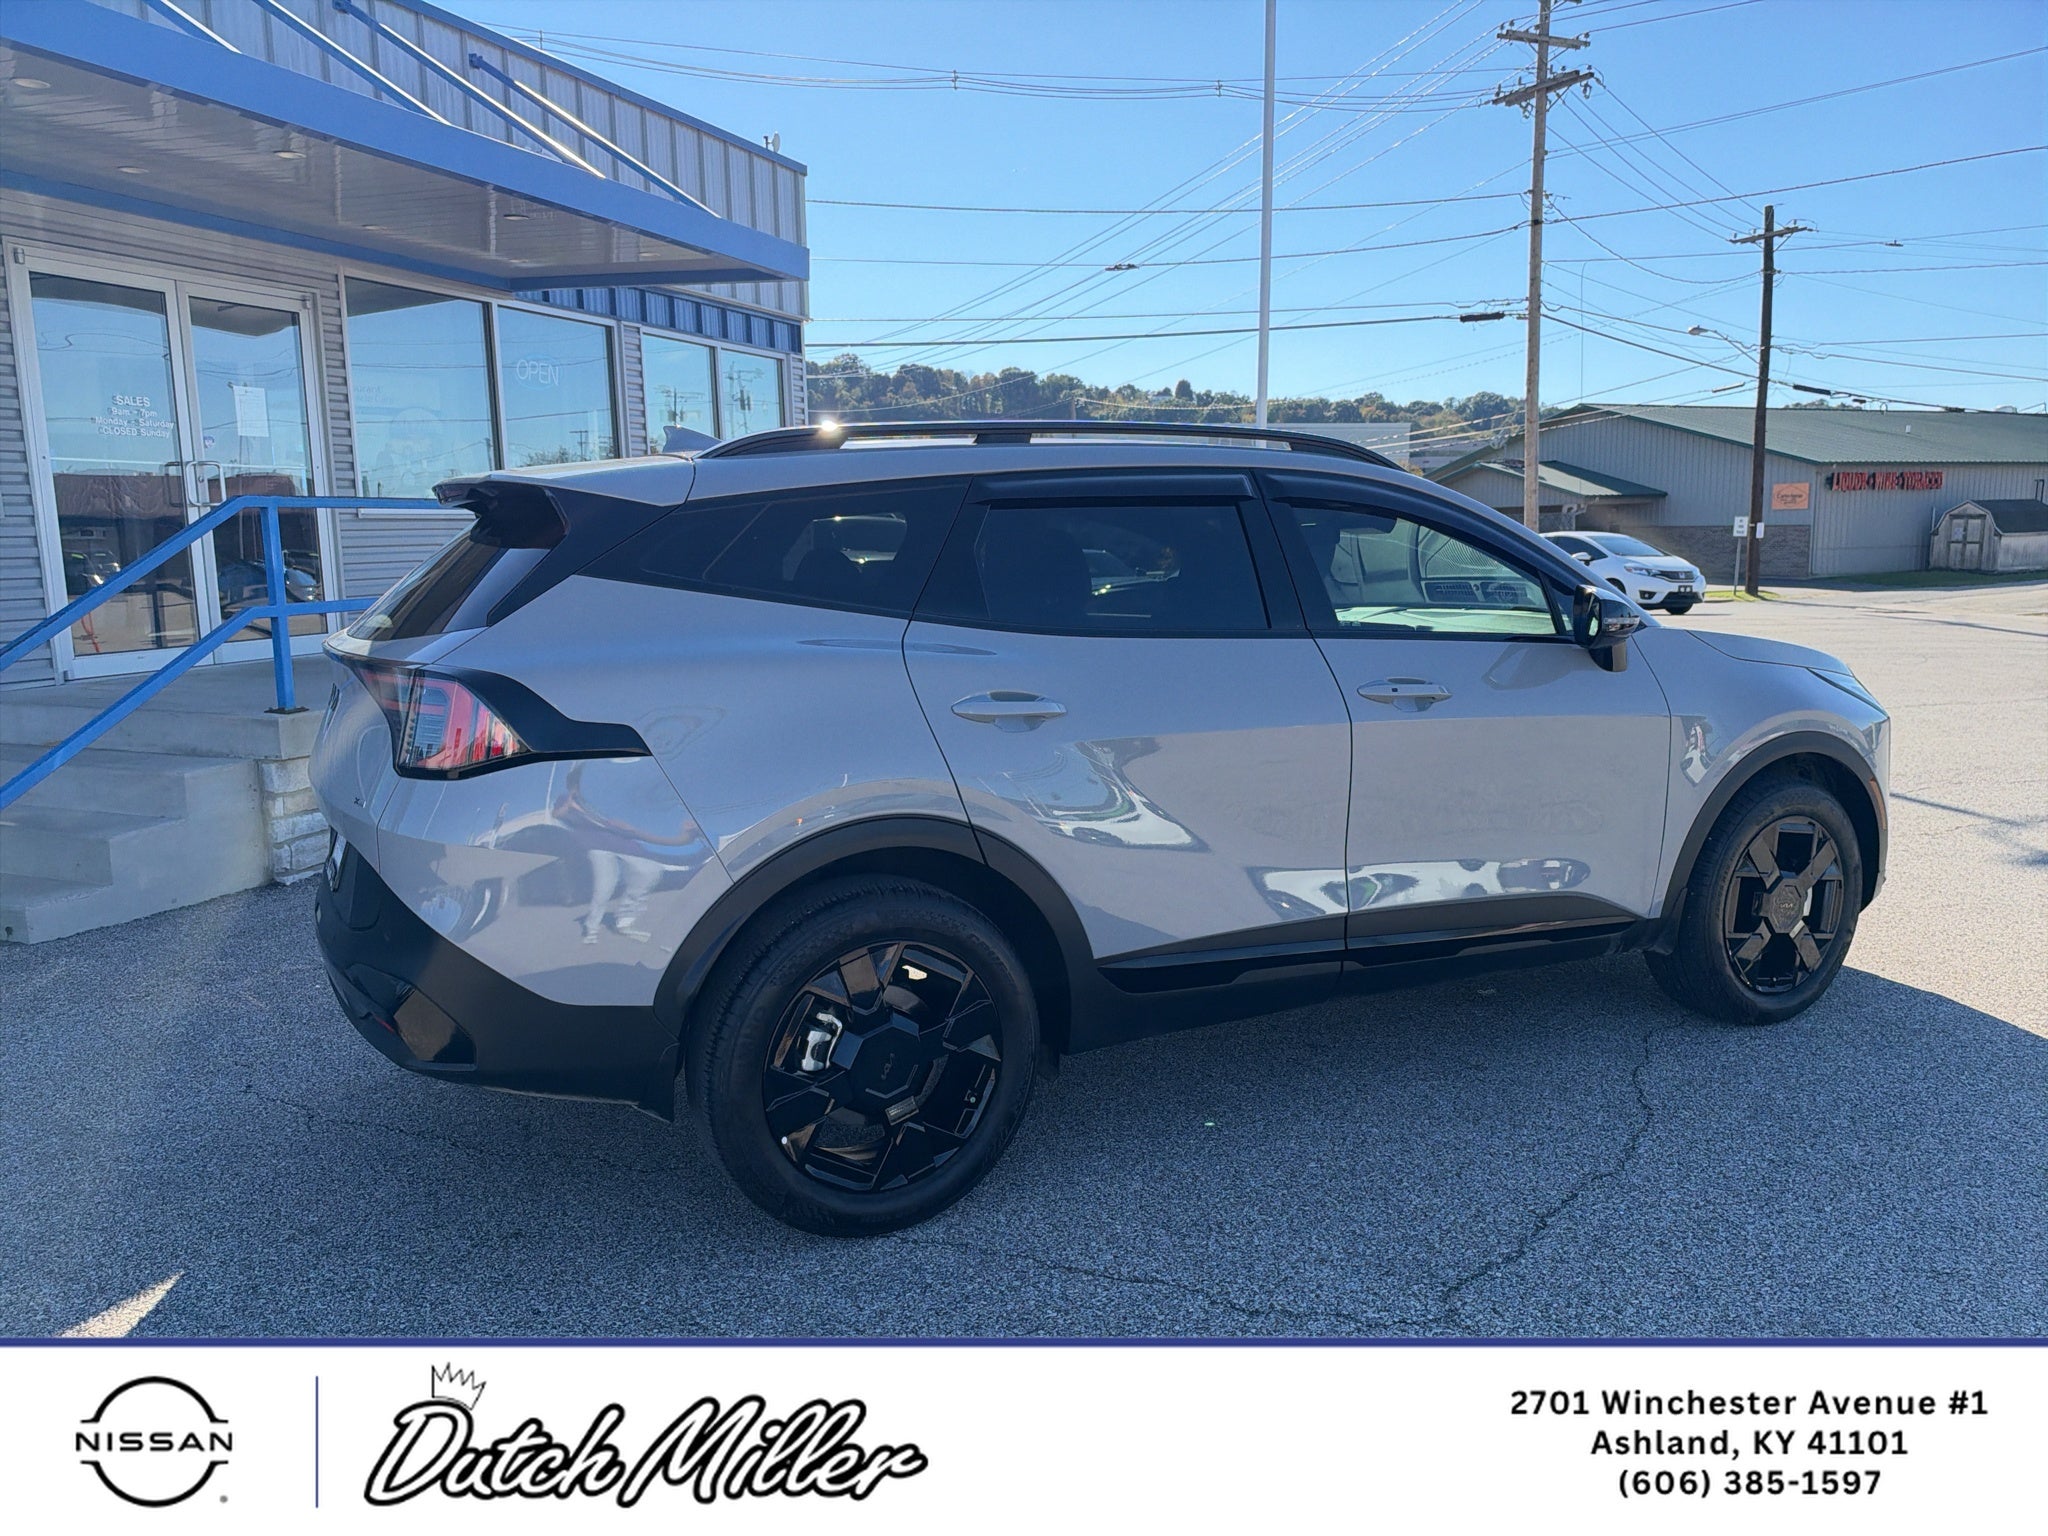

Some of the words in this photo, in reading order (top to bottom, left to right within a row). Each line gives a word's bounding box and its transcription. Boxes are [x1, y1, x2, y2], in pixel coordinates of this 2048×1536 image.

[516, 359, 559, 386] OPEN
[115, 395, 151, 407] SALES
[111, 407, 131, 416] 9am
[140, 409, 158, 418] 7pm
[95, 416, 129, 427] Monday
[139, 419, 174, 430] Saturday
[103, 426, 138, 436] CLOSED
[141, 429, 171, 438] Sunday
